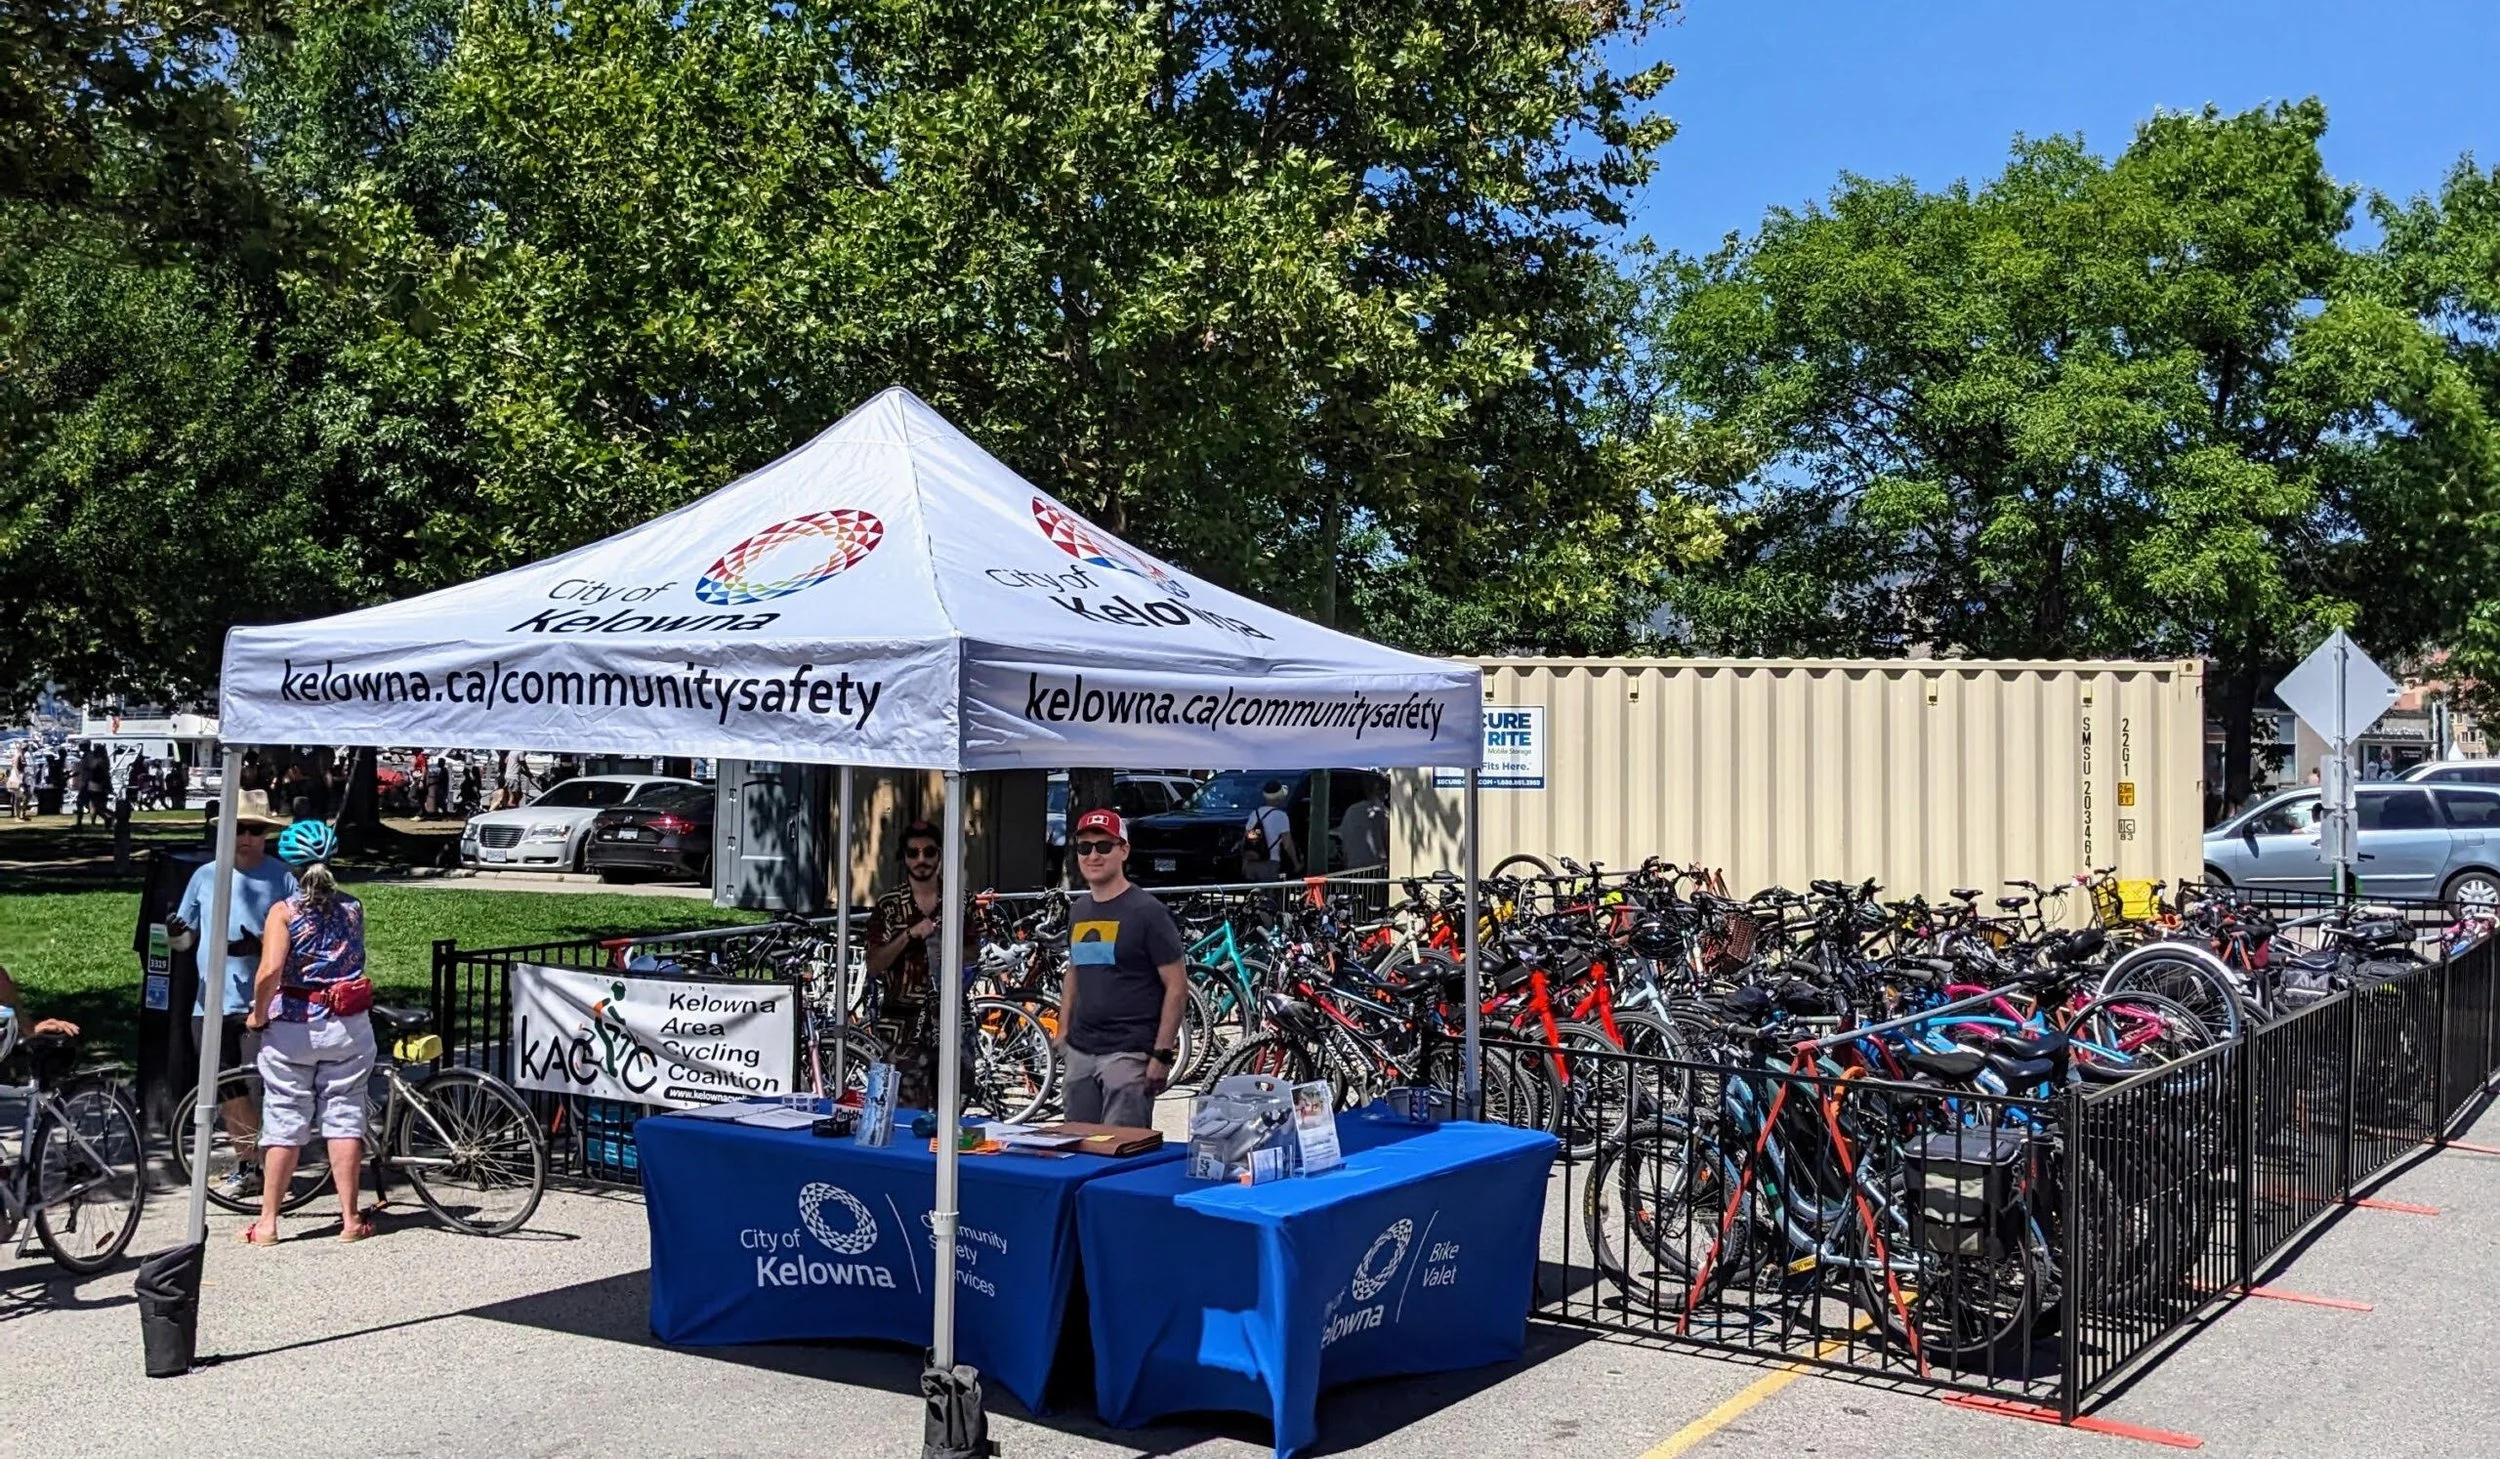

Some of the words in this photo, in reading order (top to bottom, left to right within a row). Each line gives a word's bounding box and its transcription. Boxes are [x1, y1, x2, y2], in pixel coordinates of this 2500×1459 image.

[548, 577, 628, 606] City
[621, 580, 679, 603] of
[985, 569, 1064, 593] City
[1058, 564, 1100, 590] of
[507, 608, 782, 633] Kelowna
[1049, 595, 1276, 641] Kelowna
[281, 659, 882, 730] kelowna.ca/communitysafety
[1025, 672, 1445, 741] kelowna.ca/communitysafety
[1488, 732, 1531, 746] RITE
[1509, 748, 1531, 756] Storage
[2082, 717, 2092, 776] SMSU
[2121, 718, 2130, 776] 22G1
[2084, 780, 2093, 869] 203464
[150, 959, 167, 968] 3319
[668, 992, 777, 1014] Kelowna
[660, 1016, 725, 1037] Area
[662, 1040, 761, 1068] Cycling
[667, 1065, 780, 1093] Coalition
[740, 1228, 779, 1253] City
[782, 1228, 801, 1248] of
[920, 1213, 1008, 1255] Cmunity
[928, 1234, 978, 1266] Sety
[1428, 1240, 1460, 1263] Bike
[756, 1254, 896, 1289] Kelowna
[953, 1269, 997, 1297] rvices
[1422, 1264, 1458, 1287] Valet
[1320, 1304, 1386, 1349] elowna
